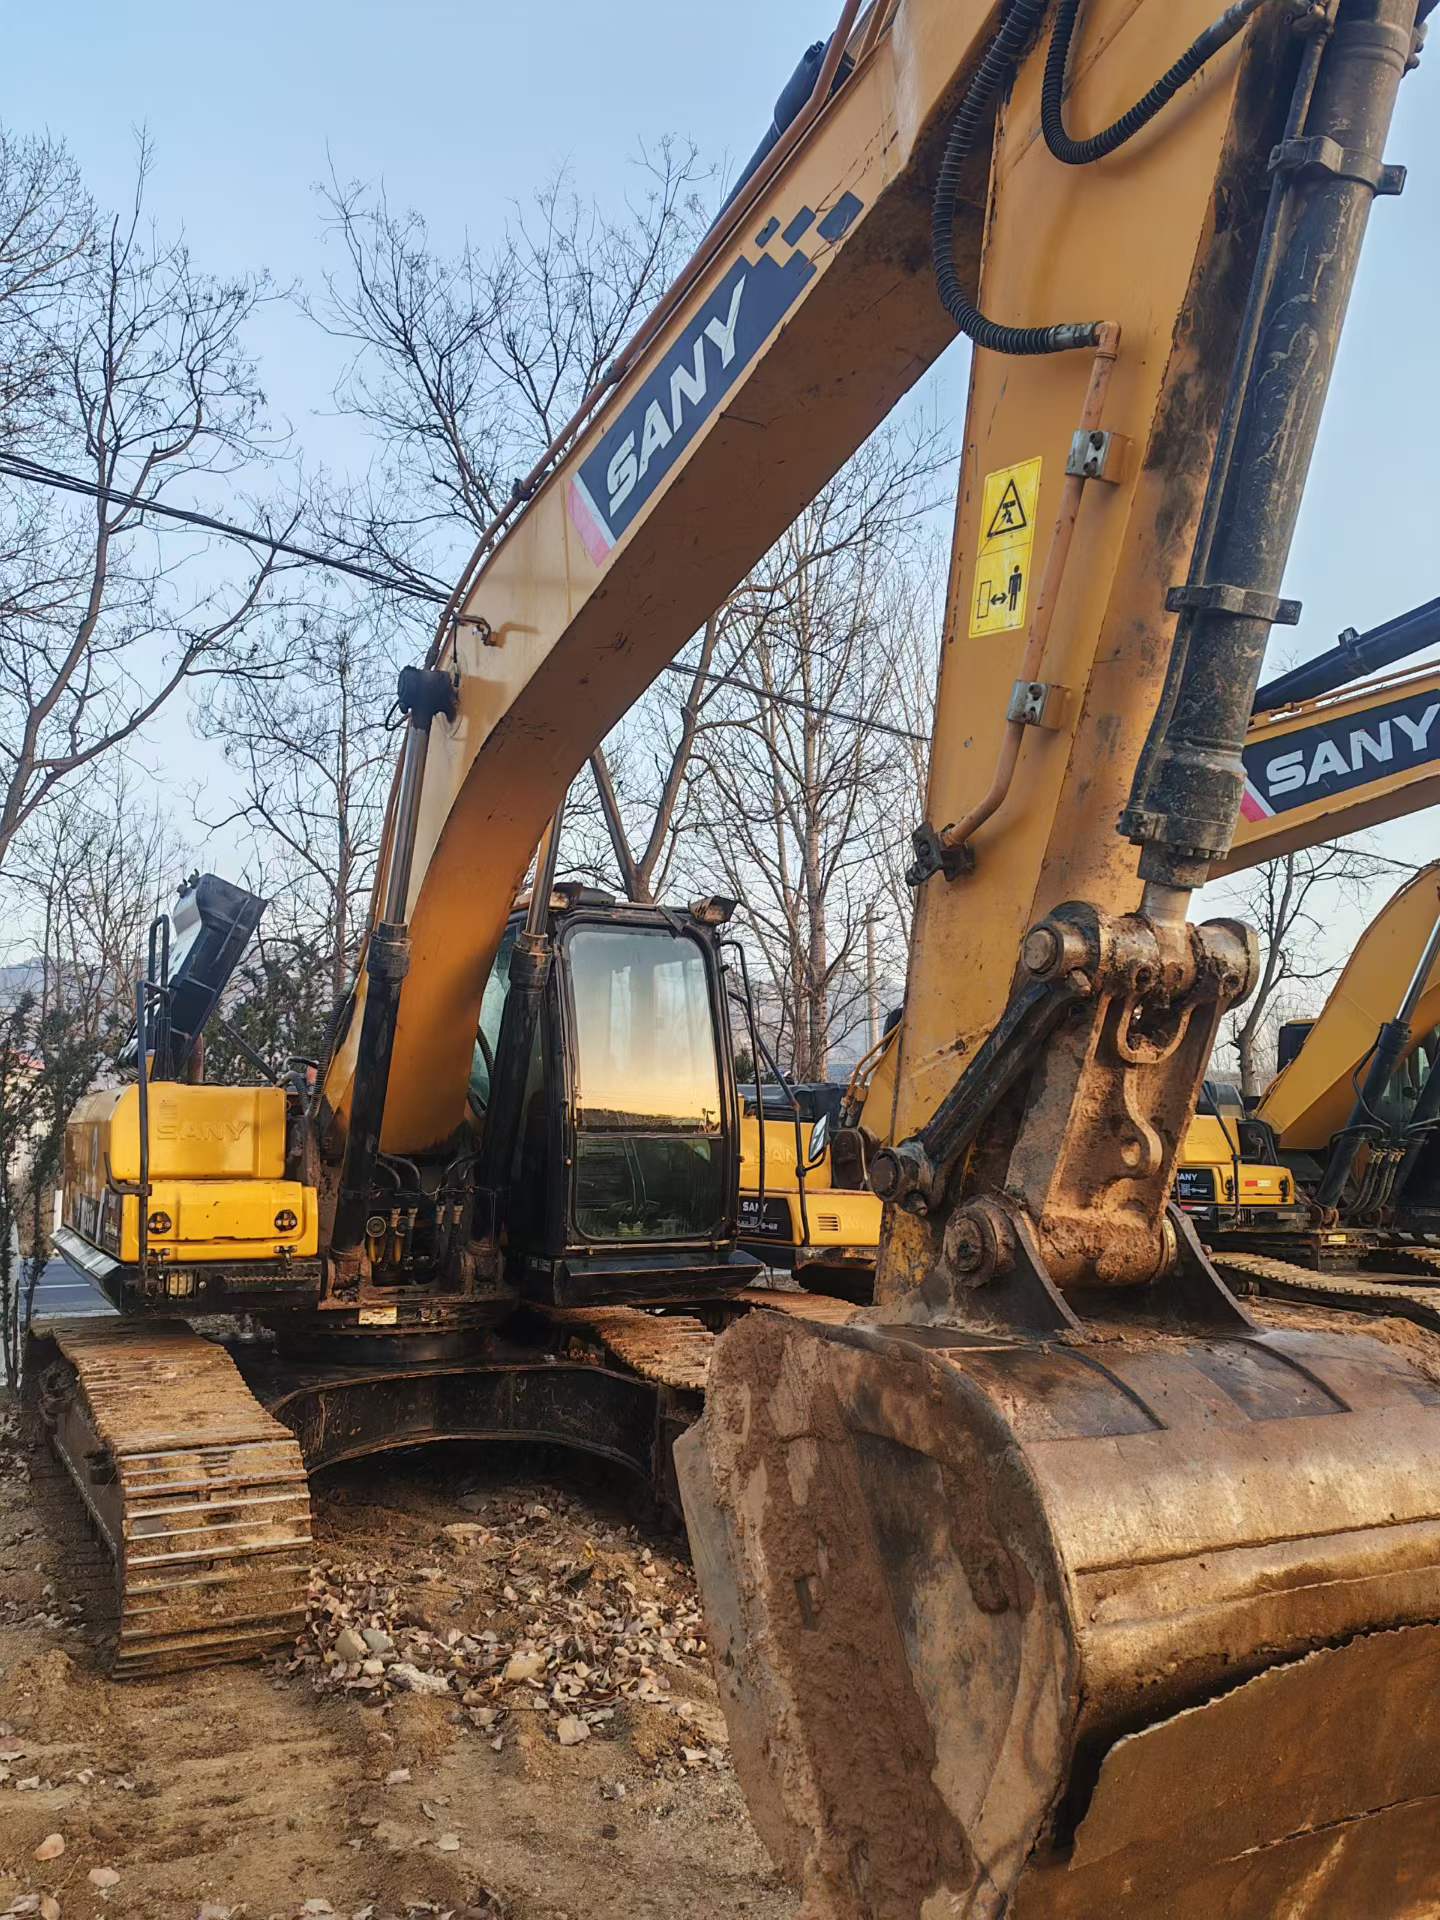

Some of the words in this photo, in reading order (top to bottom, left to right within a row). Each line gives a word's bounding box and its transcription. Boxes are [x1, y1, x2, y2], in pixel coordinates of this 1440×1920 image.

[606, 273, 746, 517] SANY
[1266, 703, 1440, 797] SANY
[156, 1120, 250, 1141] SANY
